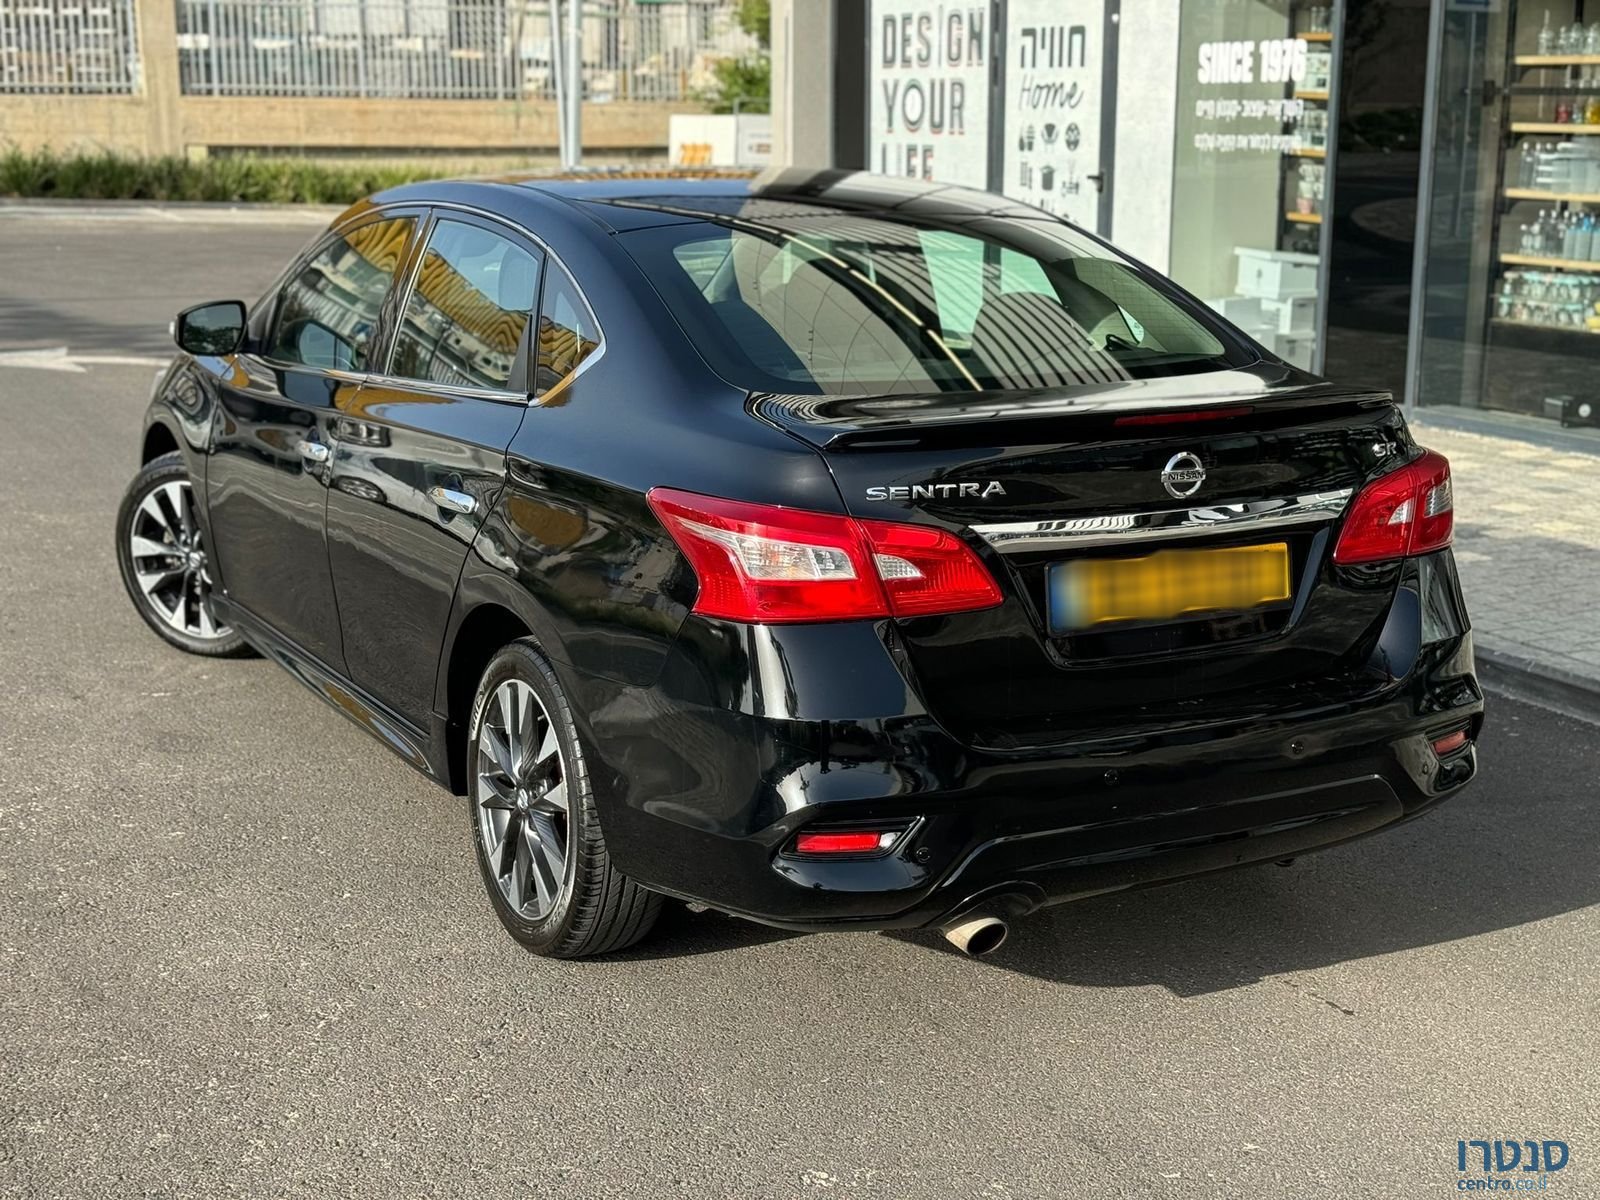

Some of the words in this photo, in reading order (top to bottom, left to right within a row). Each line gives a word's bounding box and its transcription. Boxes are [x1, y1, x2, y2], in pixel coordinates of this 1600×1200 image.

[882, 6, 985, 68] DESIGN
[1020, 25, 1086, 68] חוויה
[1198, 41, 1255, 84] SINCE
[882, 78, 965, 135] YOUR
[1019, 75, 1084, 109] Home
[865, 480, 1008, 501] SENTRA
[1168, 470, 1205, 481] NISSAN
